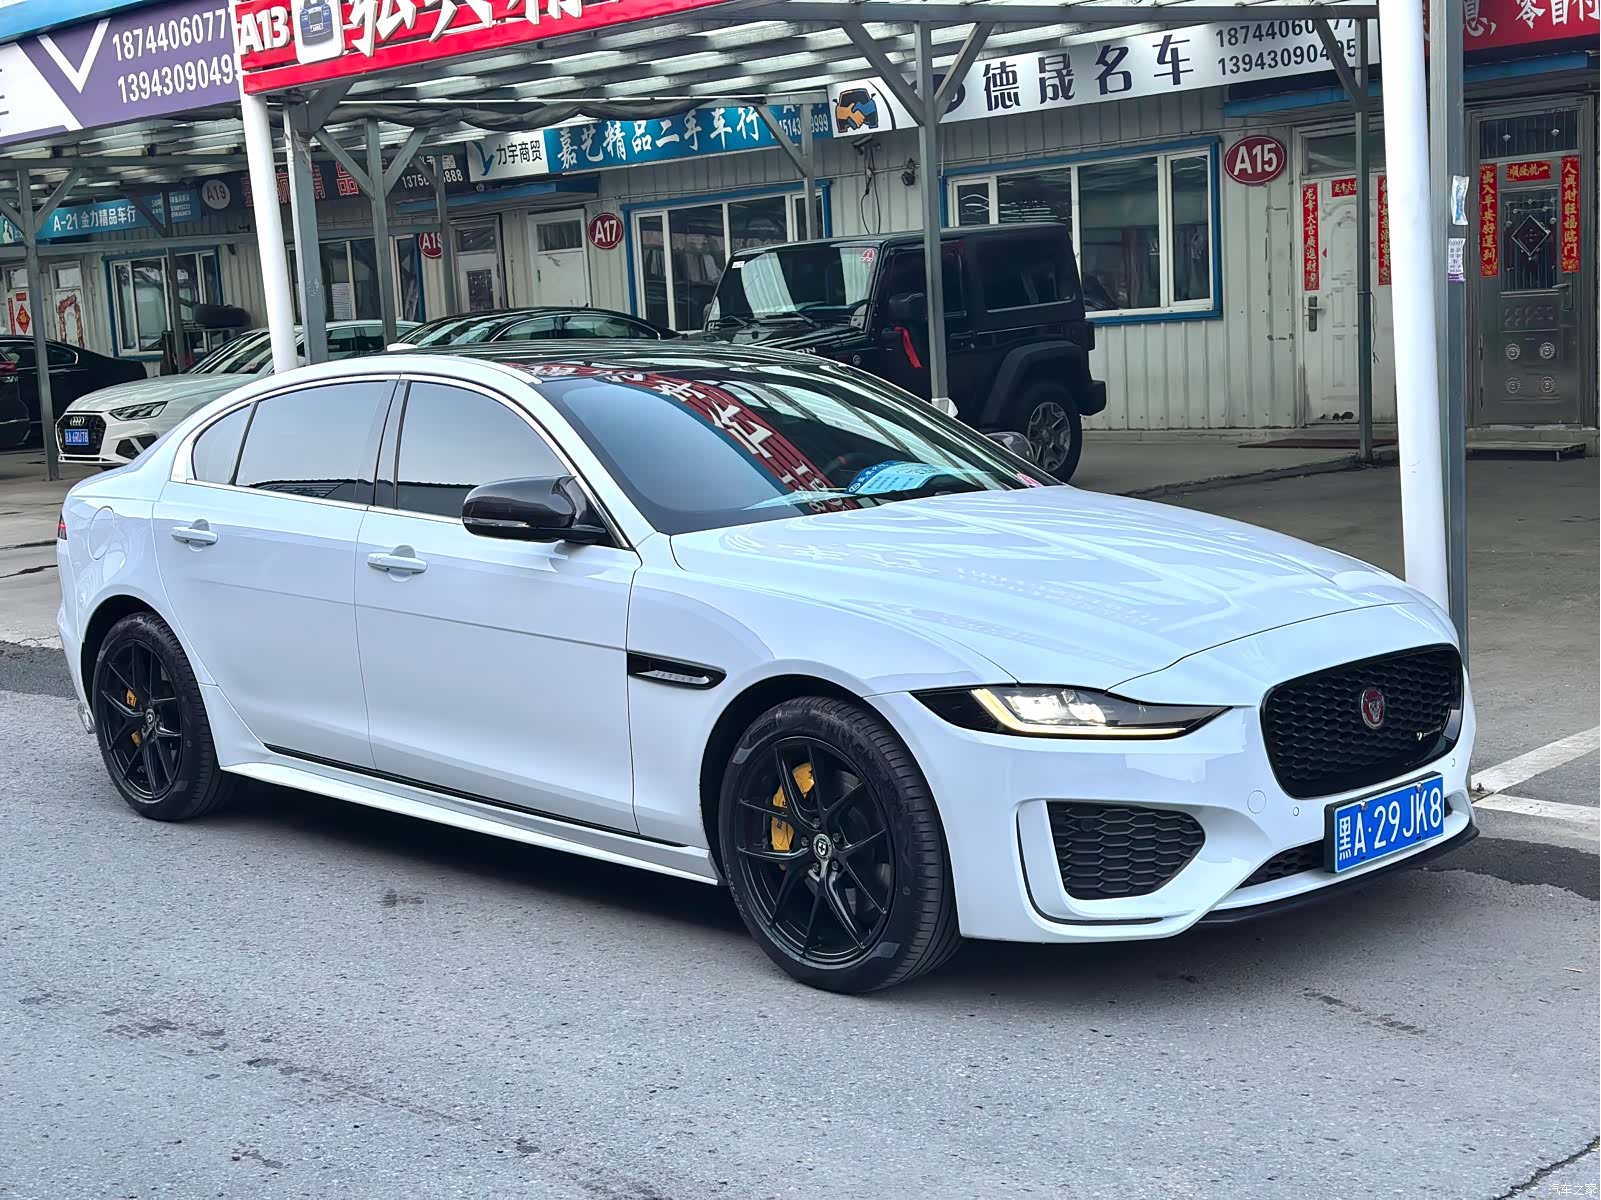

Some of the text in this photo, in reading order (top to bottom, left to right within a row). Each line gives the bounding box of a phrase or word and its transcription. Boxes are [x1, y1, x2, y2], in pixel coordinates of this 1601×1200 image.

[239, 7, 289, 54] A13
[983, 34, 1194, 111] 德晟名车
[495, 139, 543, 166] 力宇商贸
[556, 105, 760, 170] 嘉艺精品二手车行
[1233, 143, 1278, 176] A15
[206, 184, 227, 202] A19
[53, 212, 79, 232] A-21
[80, 205, 137, 229] 金力精品车行
[594, 218, 617, 243] A17
[1339, 787, 1442, 861] 黑A·29JK8
